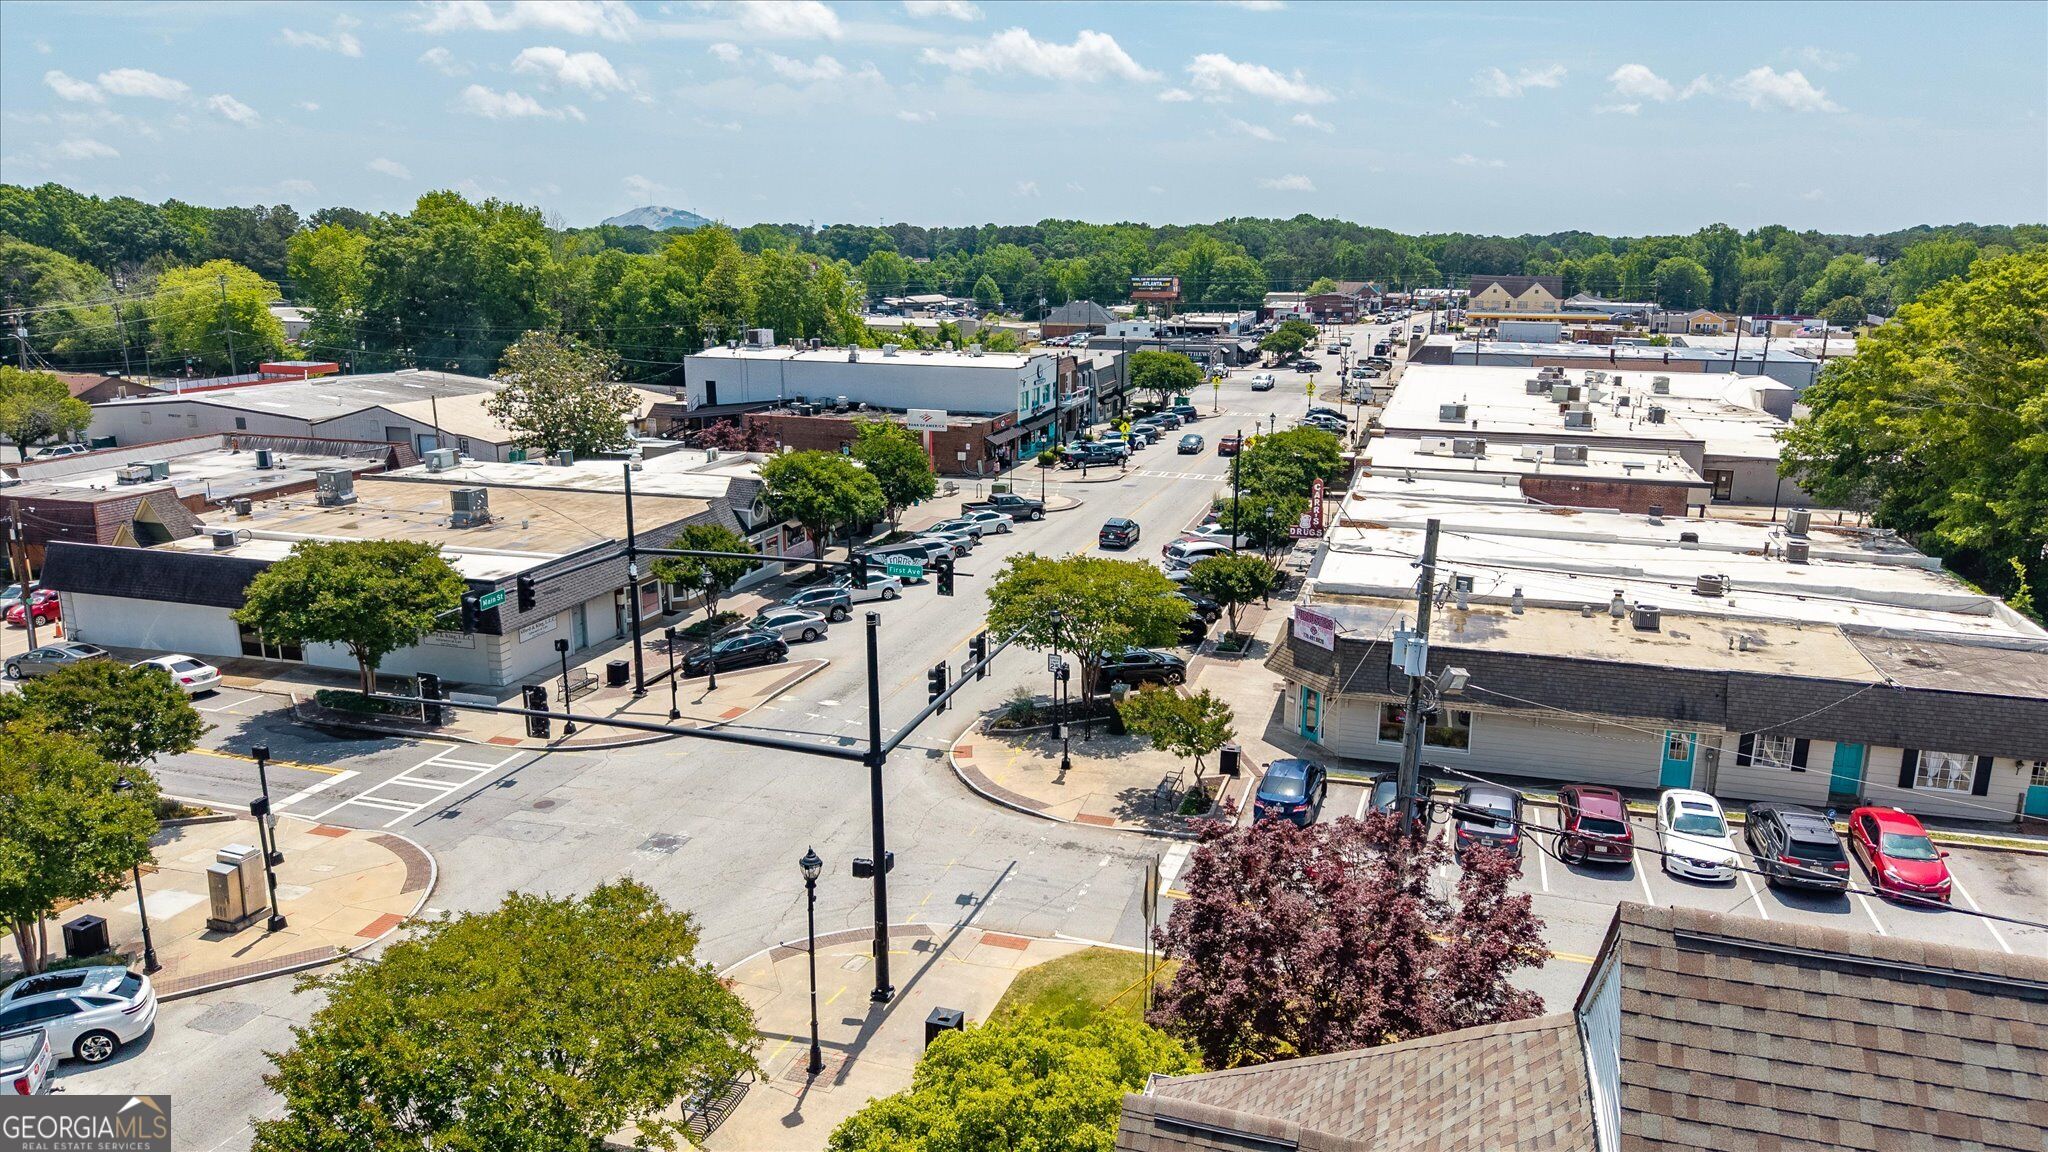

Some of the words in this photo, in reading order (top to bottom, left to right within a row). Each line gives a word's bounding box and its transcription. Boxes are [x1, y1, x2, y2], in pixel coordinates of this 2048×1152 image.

[1289, 527, 1322, 537] DRUGS
[889, 566, 905, 574] First
[482, 596, 497, 607] Main
[496, 593, 504, 602] St
